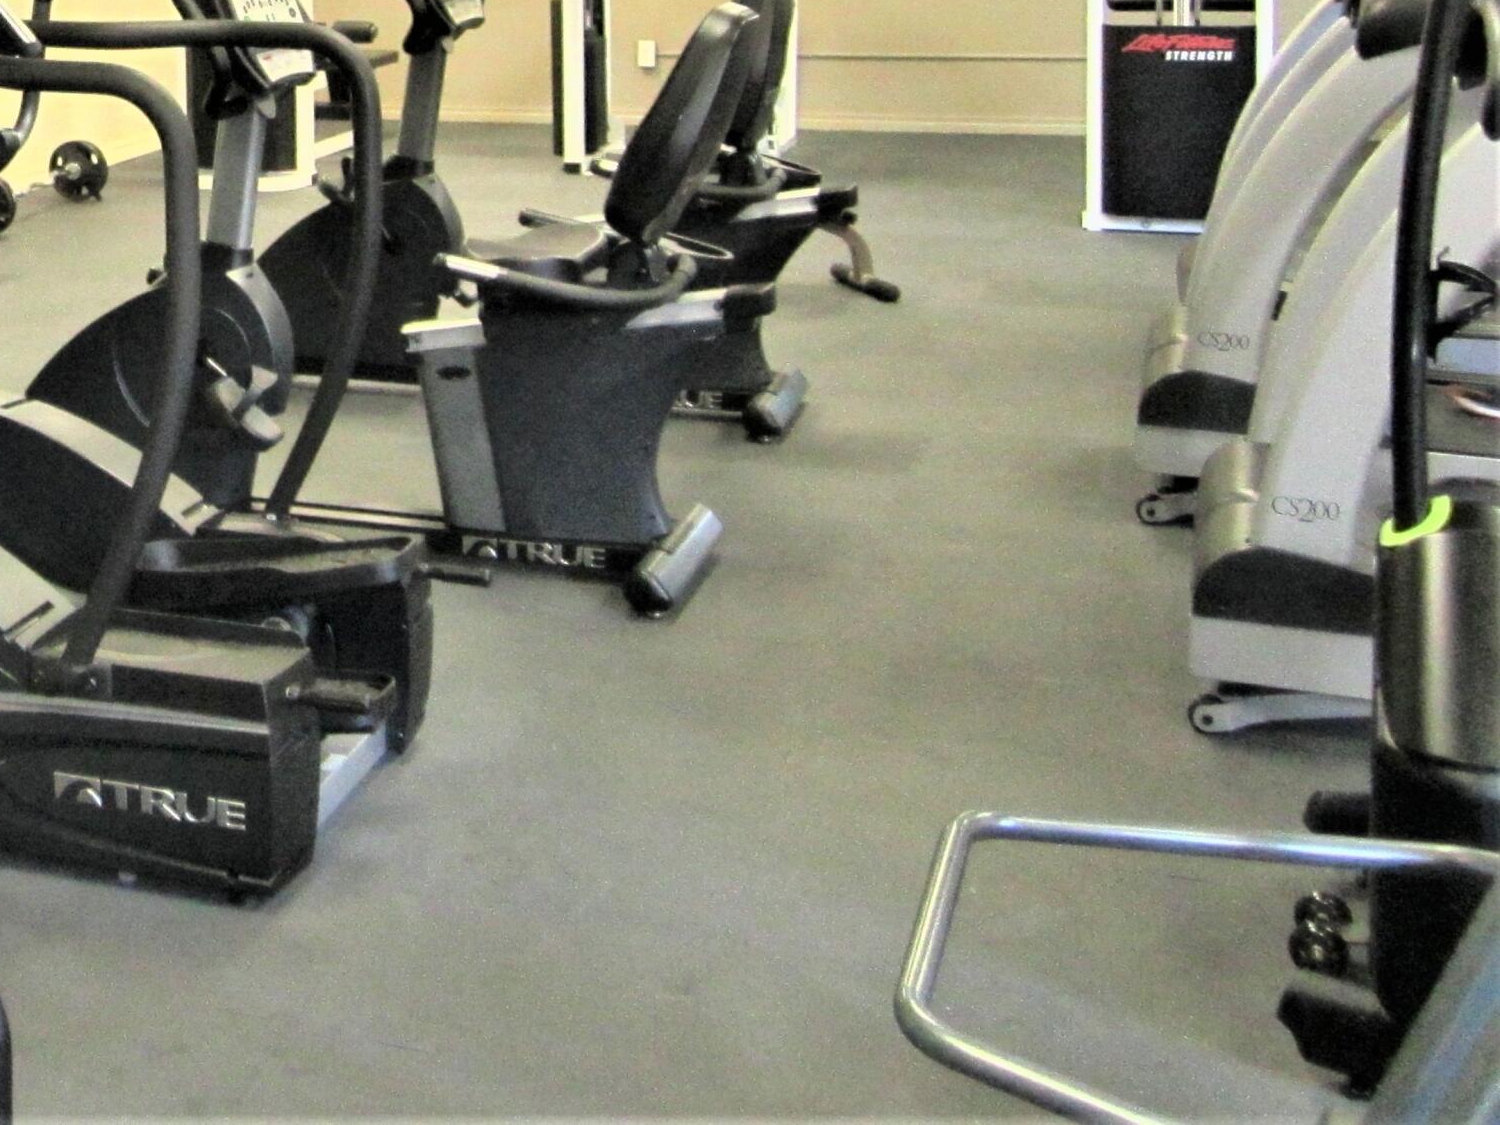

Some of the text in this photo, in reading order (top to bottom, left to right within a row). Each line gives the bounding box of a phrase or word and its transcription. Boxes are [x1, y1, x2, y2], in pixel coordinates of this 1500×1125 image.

[1165, 50, 1233, 62] STRENGTH
[1198, 331, 1251, 352] CS200
[1271, 495, 1341, 523] CS200
[499, 538, 606, 569] TRUE
[102, 778, 247, 831] TRUE
